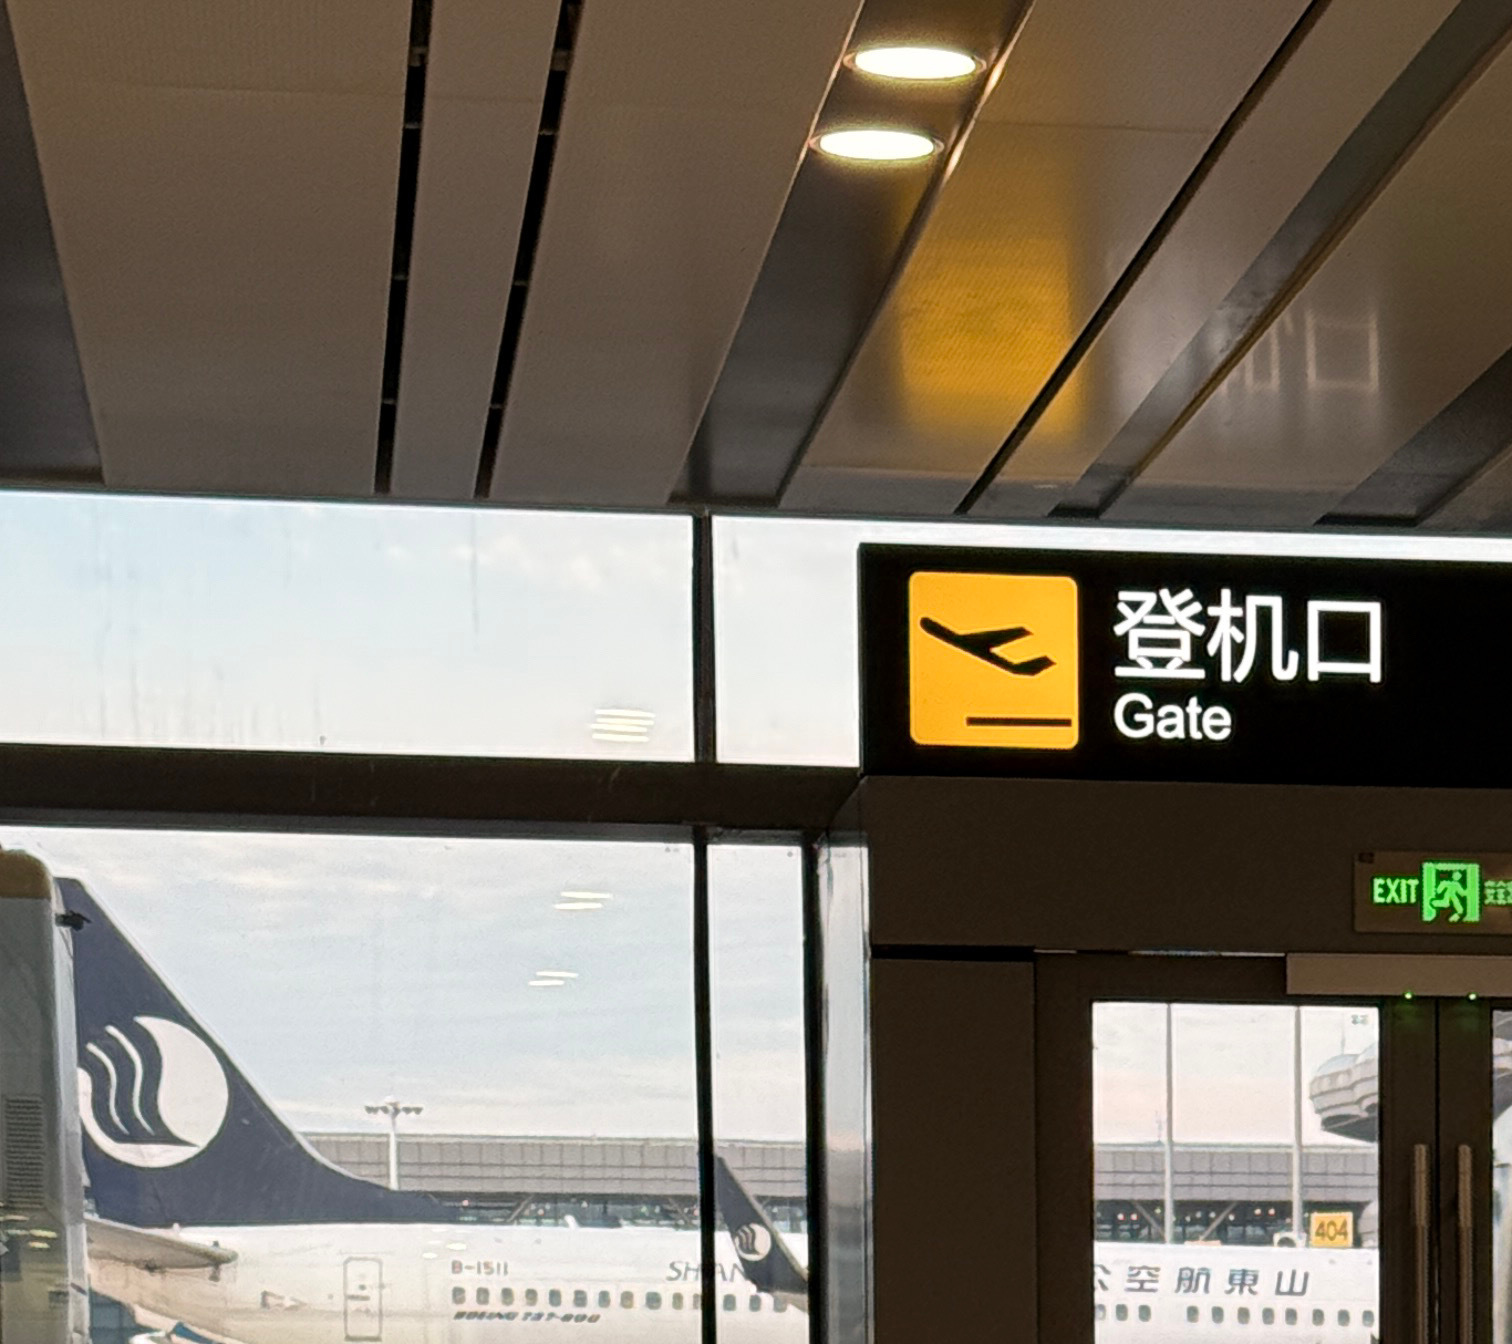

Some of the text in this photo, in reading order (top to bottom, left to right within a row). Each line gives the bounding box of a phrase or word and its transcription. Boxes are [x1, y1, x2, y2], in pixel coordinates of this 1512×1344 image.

[1113, 588, 1382, 683] 登机口
[1114, 693, 1232, 740] Gate
[1373, 878, 1419, 904] EXIT
[1314, 1219, 1349, 1242] 404
